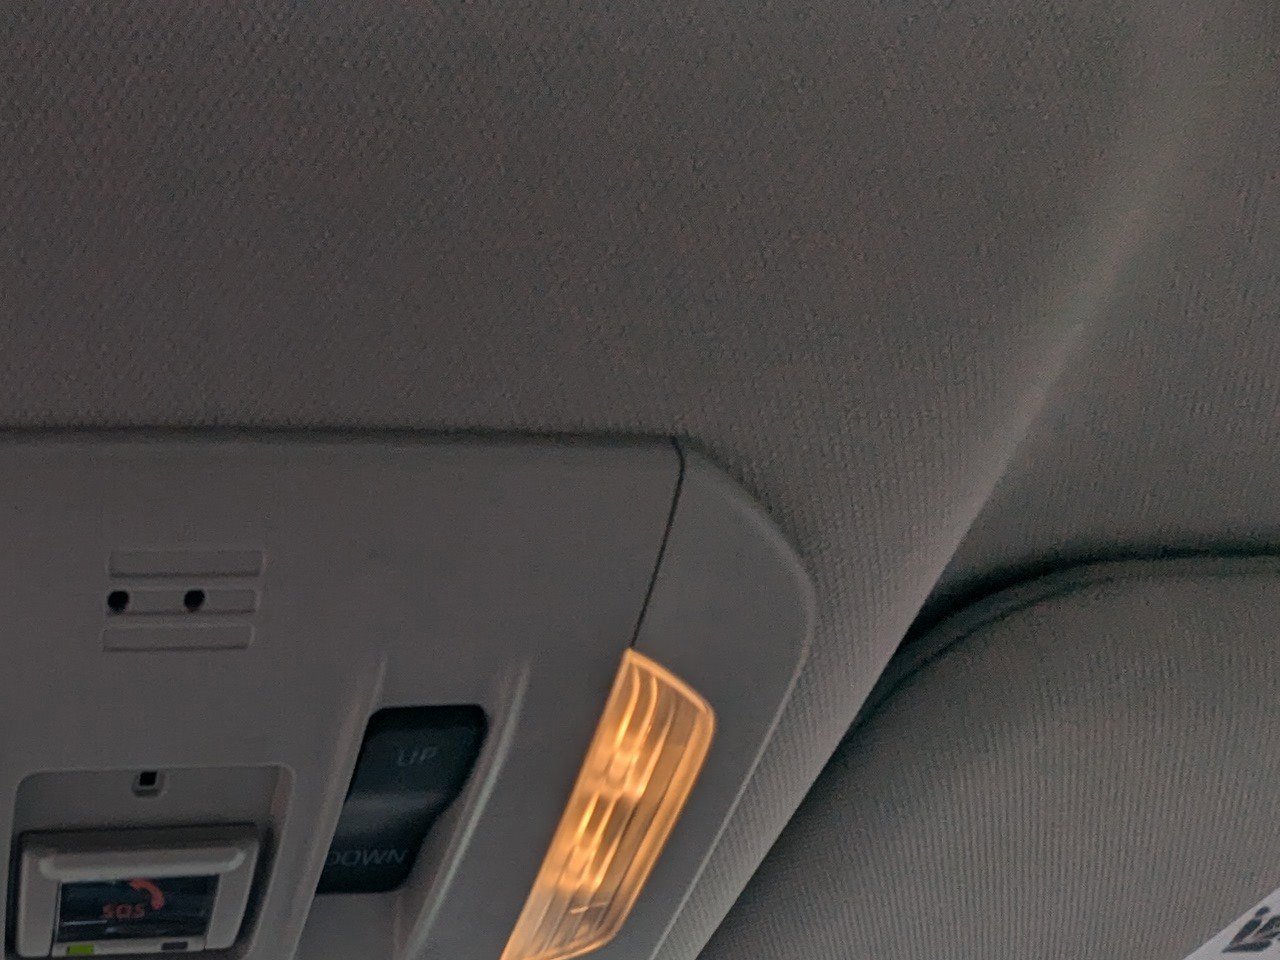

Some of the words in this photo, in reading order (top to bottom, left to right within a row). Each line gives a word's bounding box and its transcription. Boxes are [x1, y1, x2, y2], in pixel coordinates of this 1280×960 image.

[397, 746, 437, 767] UP
[327, 849, 407, 866] DOWN
[102, 903, 146, 921] SOS
